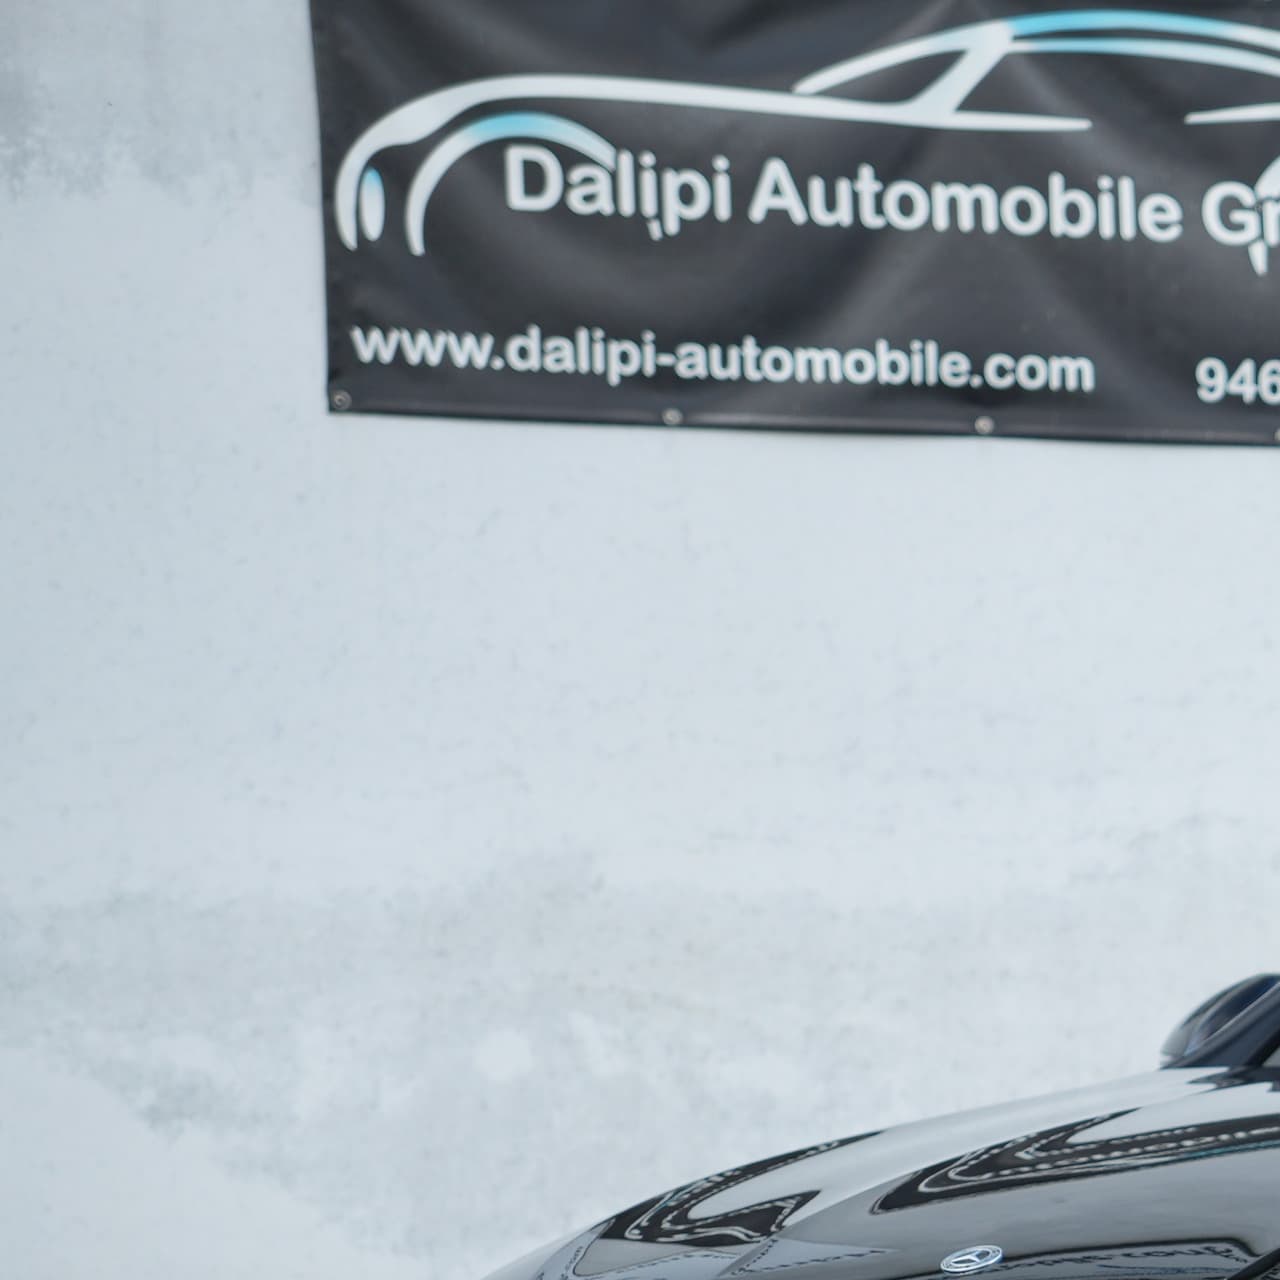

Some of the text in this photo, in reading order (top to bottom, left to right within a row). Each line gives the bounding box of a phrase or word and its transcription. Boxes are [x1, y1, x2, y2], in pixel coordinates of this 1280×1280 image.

[505, 143, 733, 236] Dalipi
[748, 156, 1183, 242] Automobile
[351, 324, 1095, 392] www.dalipi-automobile.com
